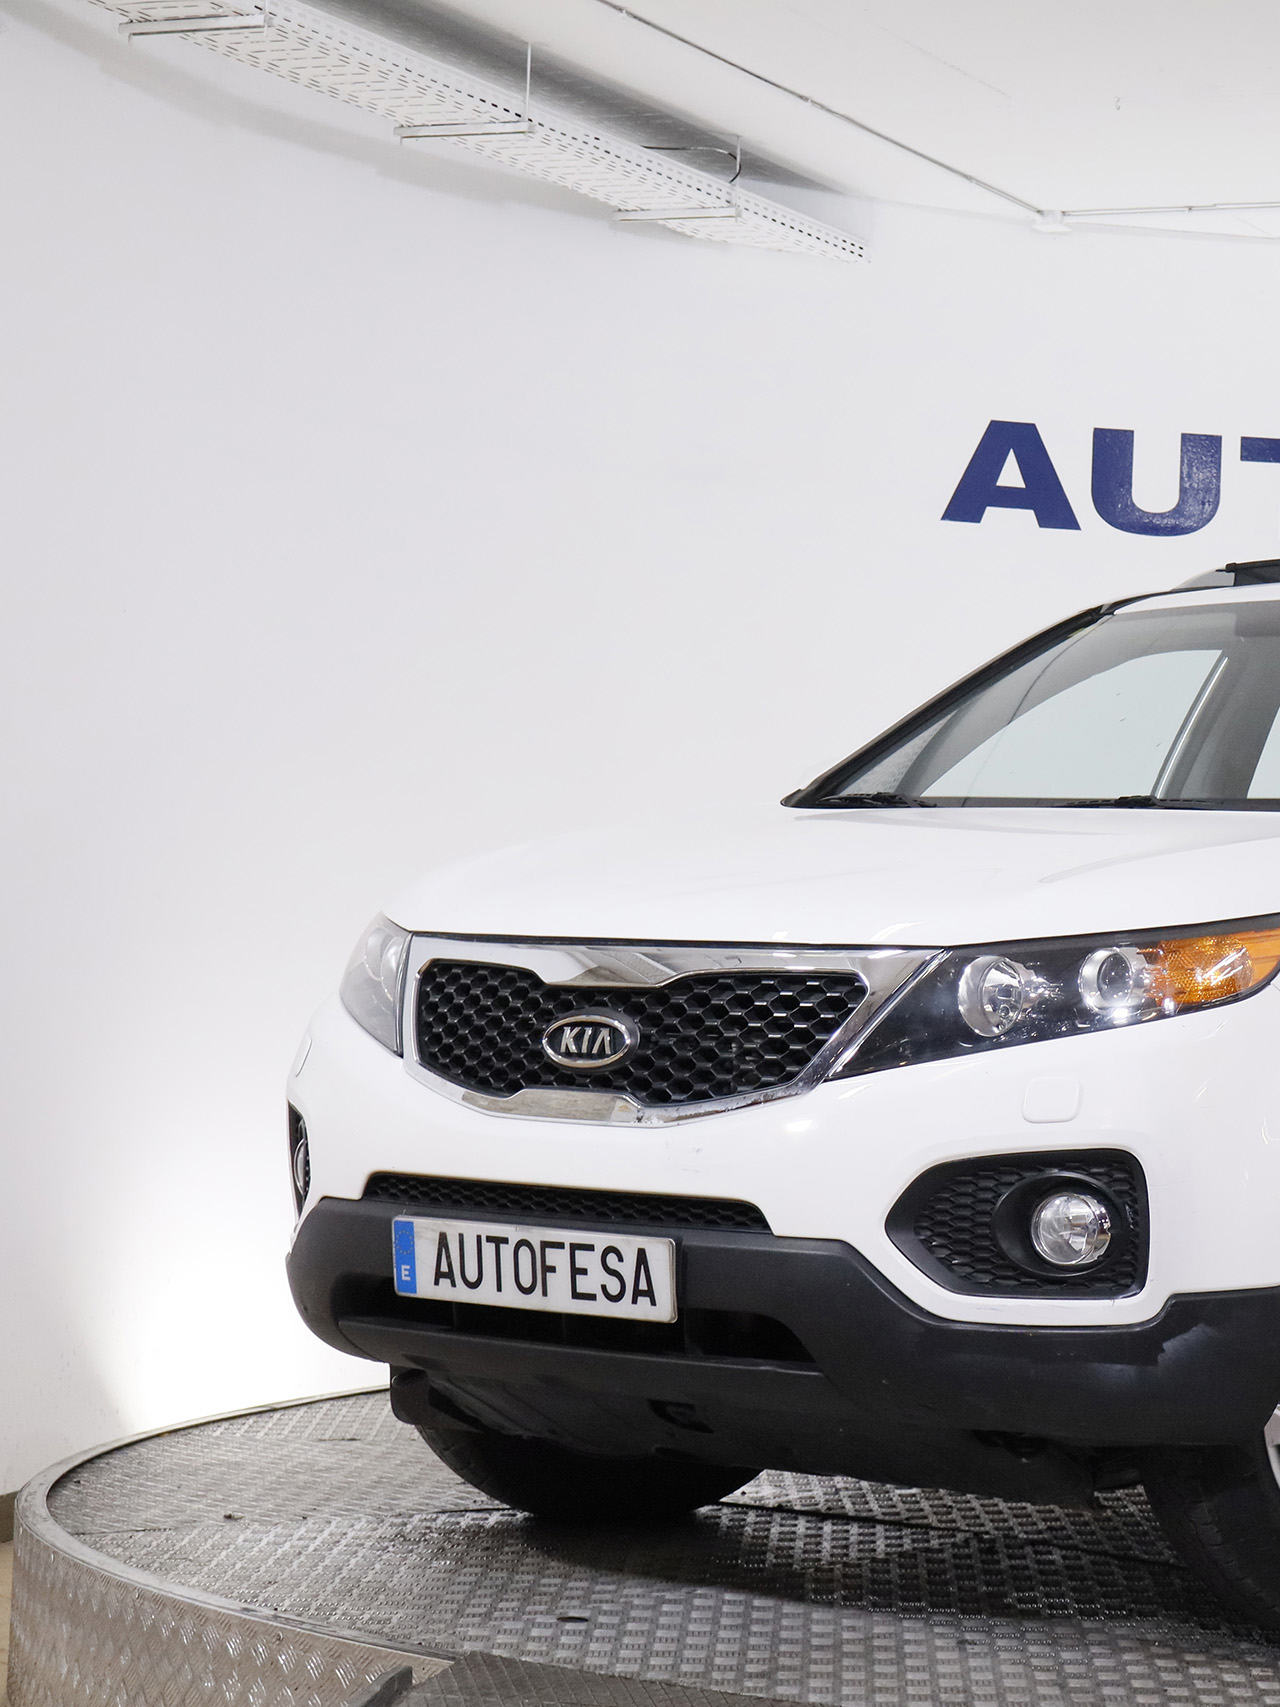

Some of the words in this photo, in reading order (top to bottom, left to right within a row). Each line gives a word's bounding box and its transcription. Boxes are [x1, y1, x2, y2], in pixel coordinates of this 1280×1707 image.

[560, 1026, 612, 1055] KIA
[401, 1265, 411, 1281] E
[433, 1231, 657, 1307] AUTOFESA
